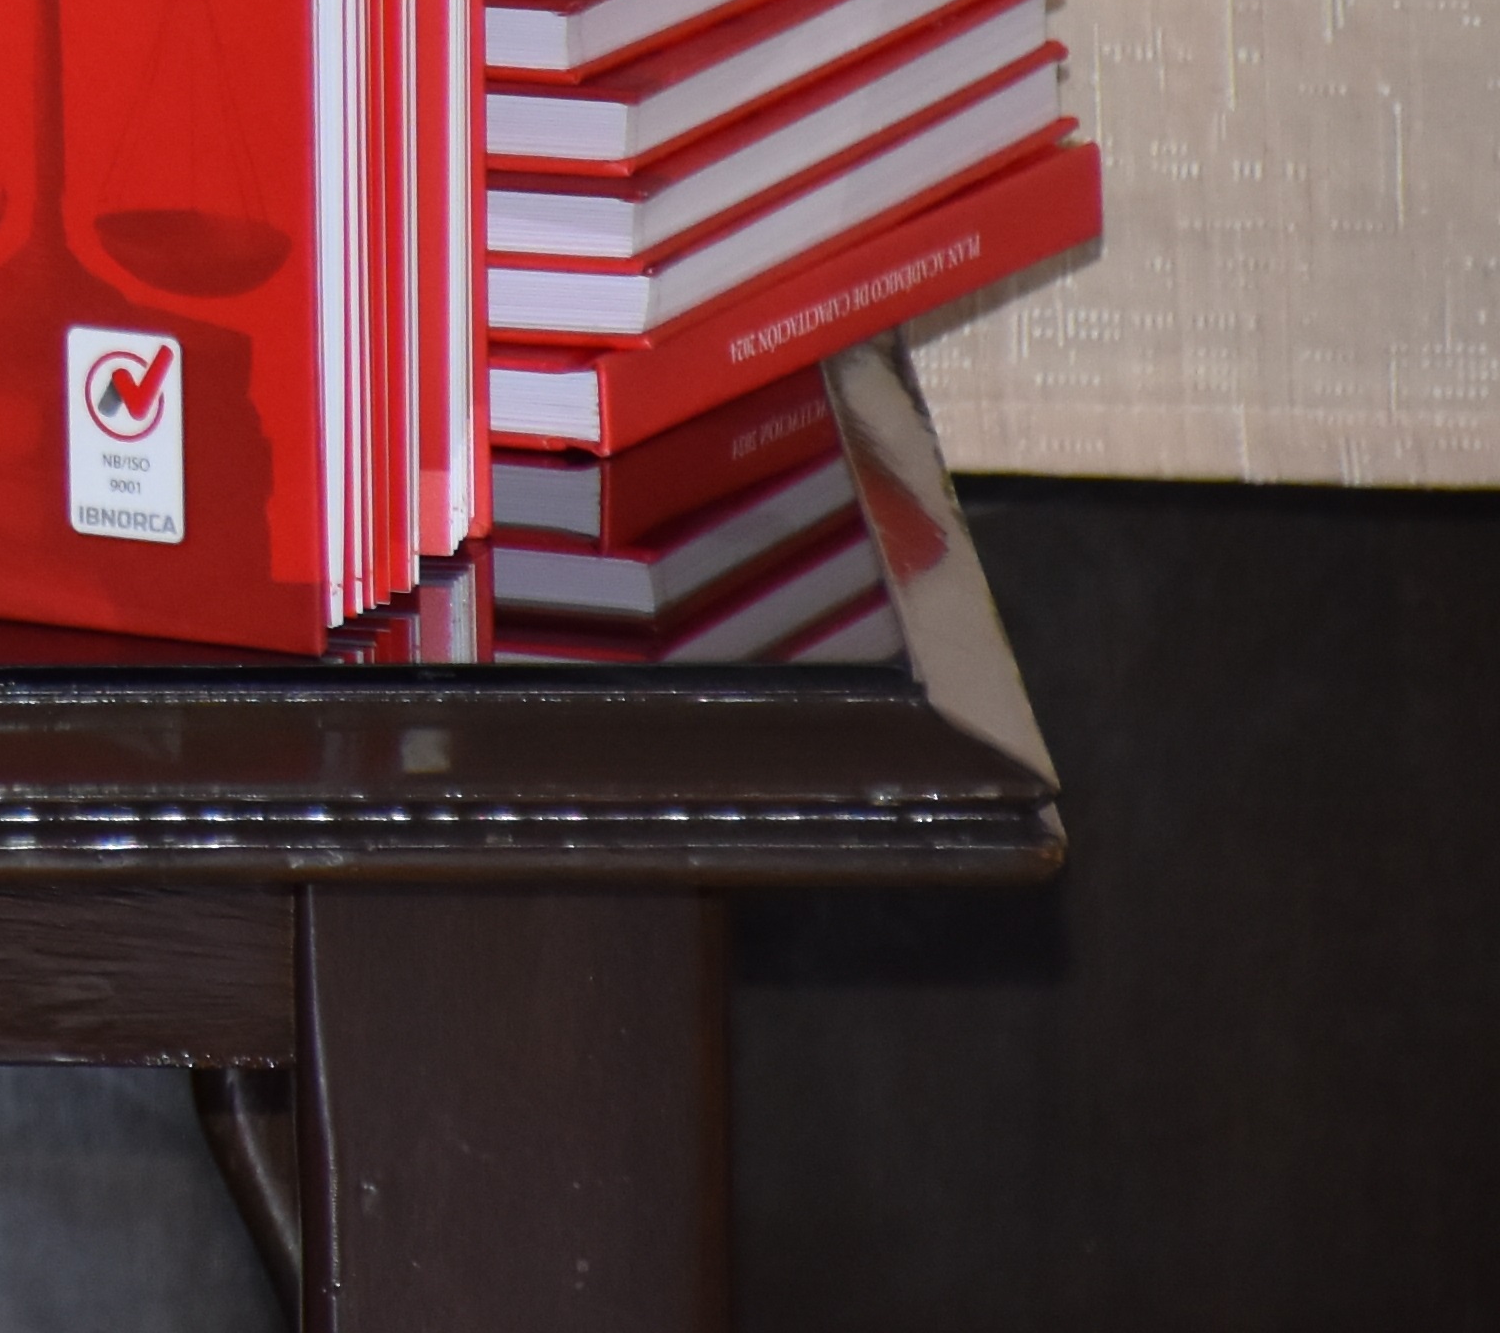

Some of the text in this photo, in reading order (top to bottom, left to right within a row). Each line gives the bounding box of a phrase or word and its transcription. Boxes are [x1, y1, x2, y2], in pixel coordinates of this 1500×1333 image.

[103, 454, 150, 472] NB/ISO
[109, 480, 141, 494] 9001
[79, 506, 177, 534] IBNORCA
